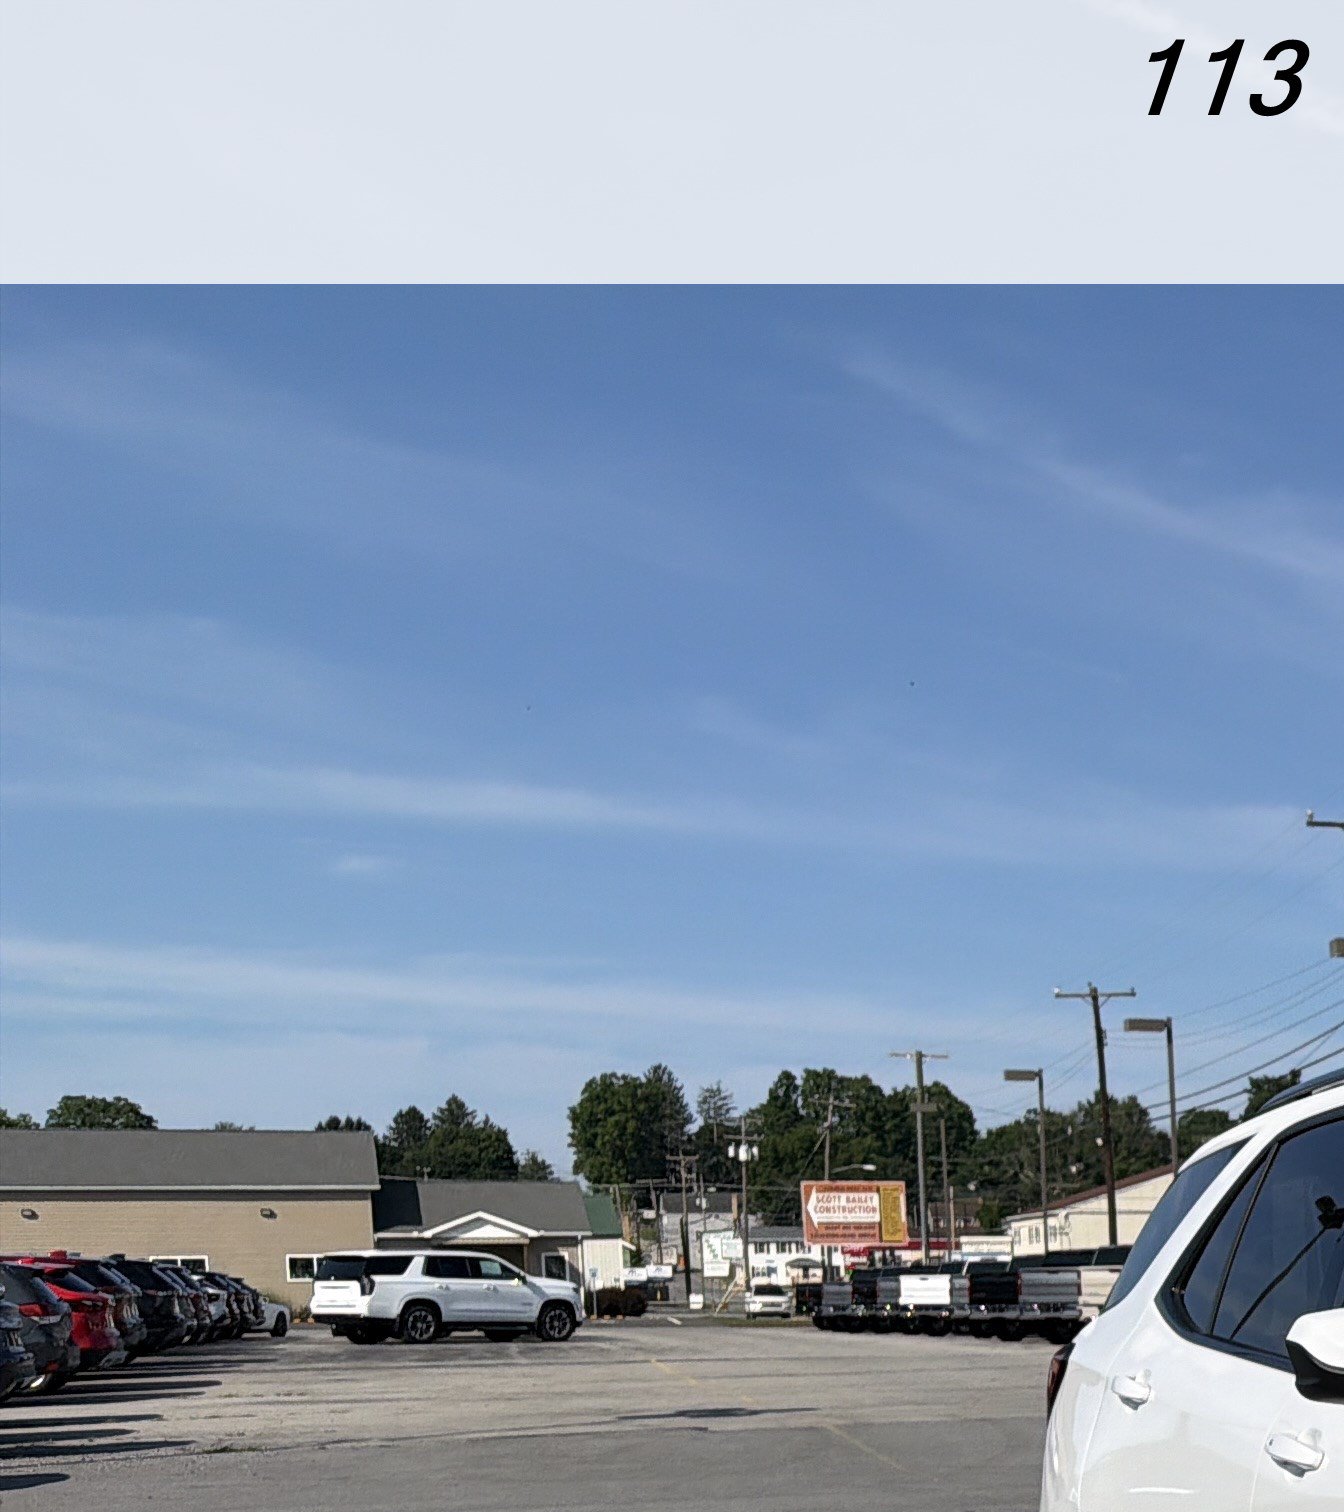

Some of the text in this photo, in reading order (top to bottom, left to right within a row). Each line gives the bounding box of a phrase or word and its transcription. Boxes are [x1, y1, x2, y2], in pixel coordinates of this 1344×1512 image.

[816, 1194, 874, 1204] SCOTT BAILEY
[814, 1205, 877, 1214] CONSTRUCTION
